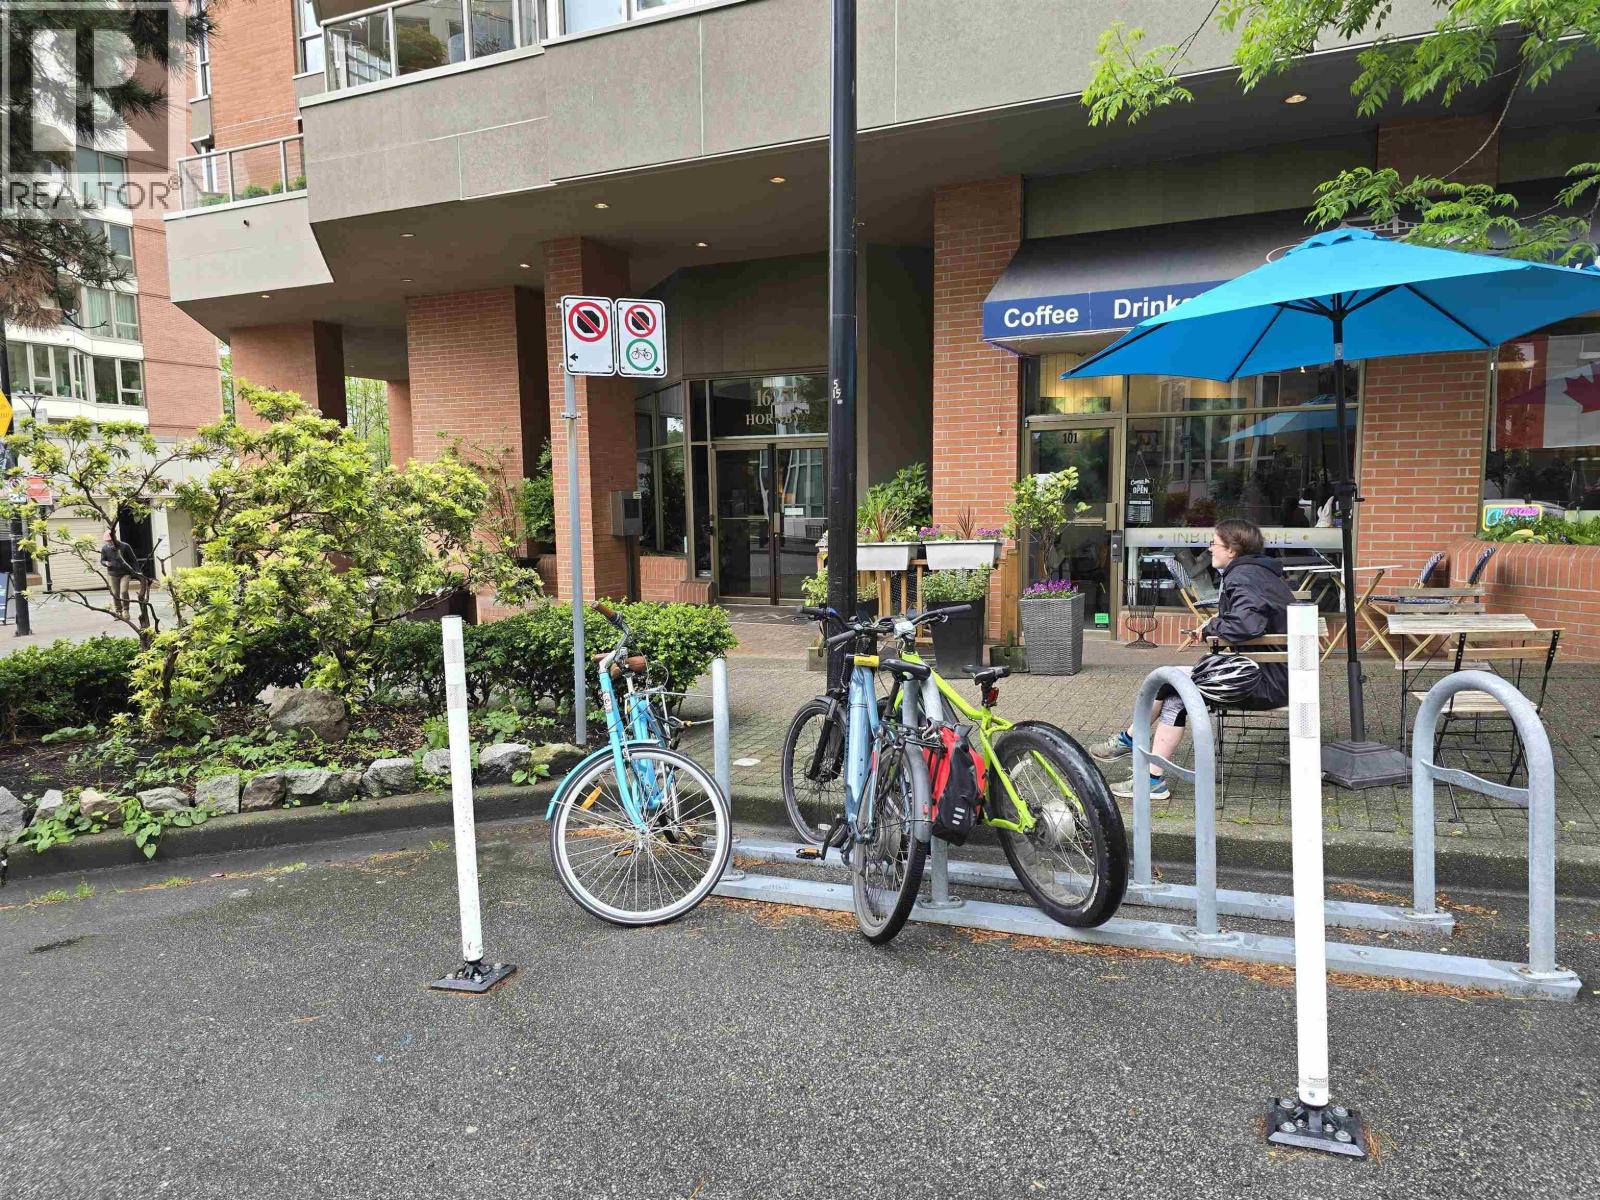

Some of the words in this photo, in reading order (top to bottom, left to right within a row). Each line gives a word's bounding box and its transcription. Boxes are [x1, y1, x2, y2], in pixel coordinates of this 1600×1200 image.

[1003, 304, 1079, 328] Coffee
[833, 379, 839, 389] 5
[832, 388, 842, 399] 15
[1063, 432, 1078, 444] 101
[1132, 485, 1149, 494] OPEN
